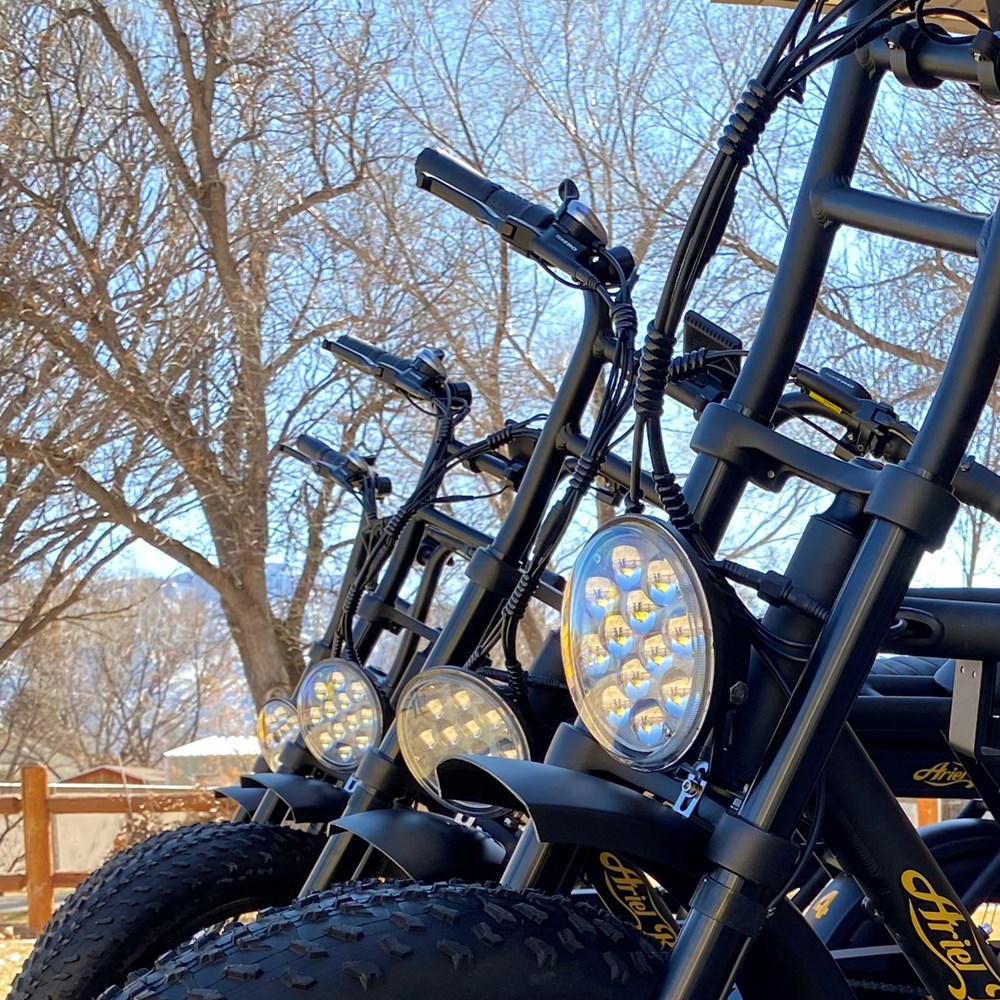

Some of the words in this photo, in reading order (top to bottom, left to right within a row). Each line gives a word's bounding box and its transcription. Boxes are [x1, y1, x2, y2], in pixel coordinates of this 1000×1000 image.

[913, 761, 976, 789] Ariel
[600, 852, 657, 931] Ariel
[812, 889, 840, 919] 4
[901, 869, 988, 1000] Ariel
